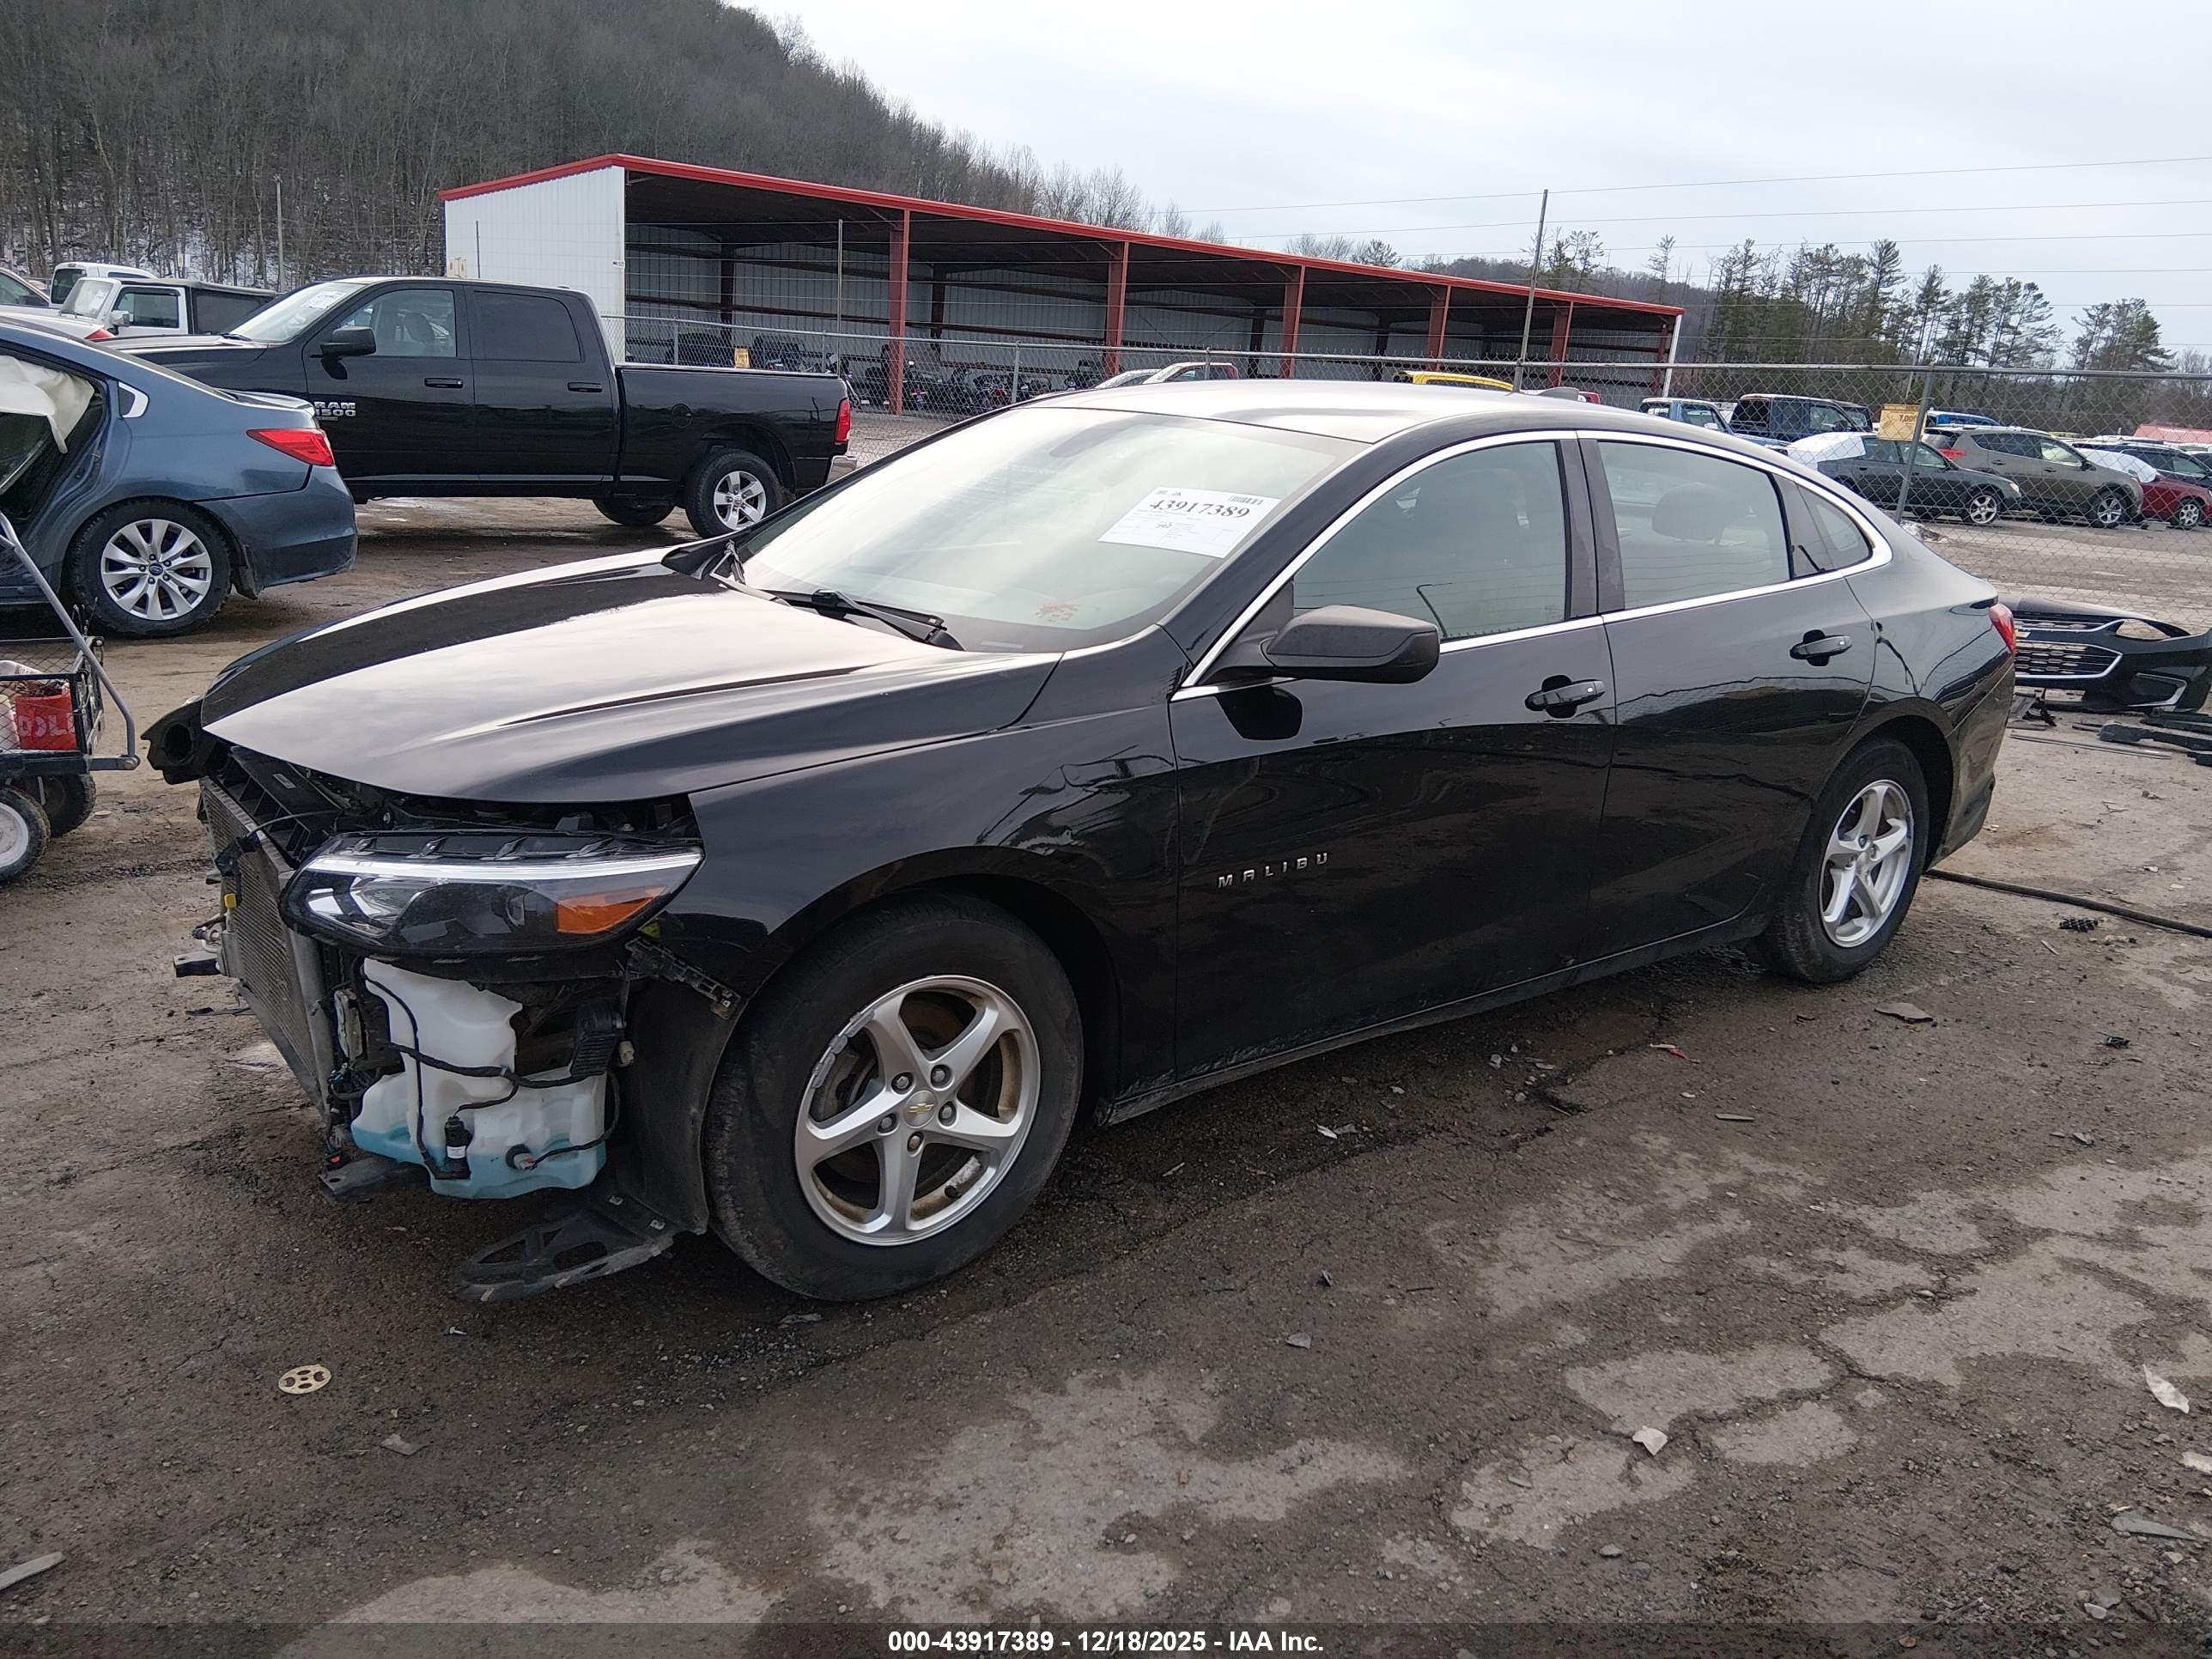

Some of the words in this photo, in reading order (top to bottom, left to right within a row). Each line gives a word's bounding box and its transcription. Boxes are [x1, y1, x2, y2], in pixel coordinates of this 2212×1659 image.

[313, 401, 356, 410] RAM
[315, 409, 356, 417] 1500
[1149, 499, 1251, 519] 43917389
[1218, 852, 1328, 889] MALIBU
